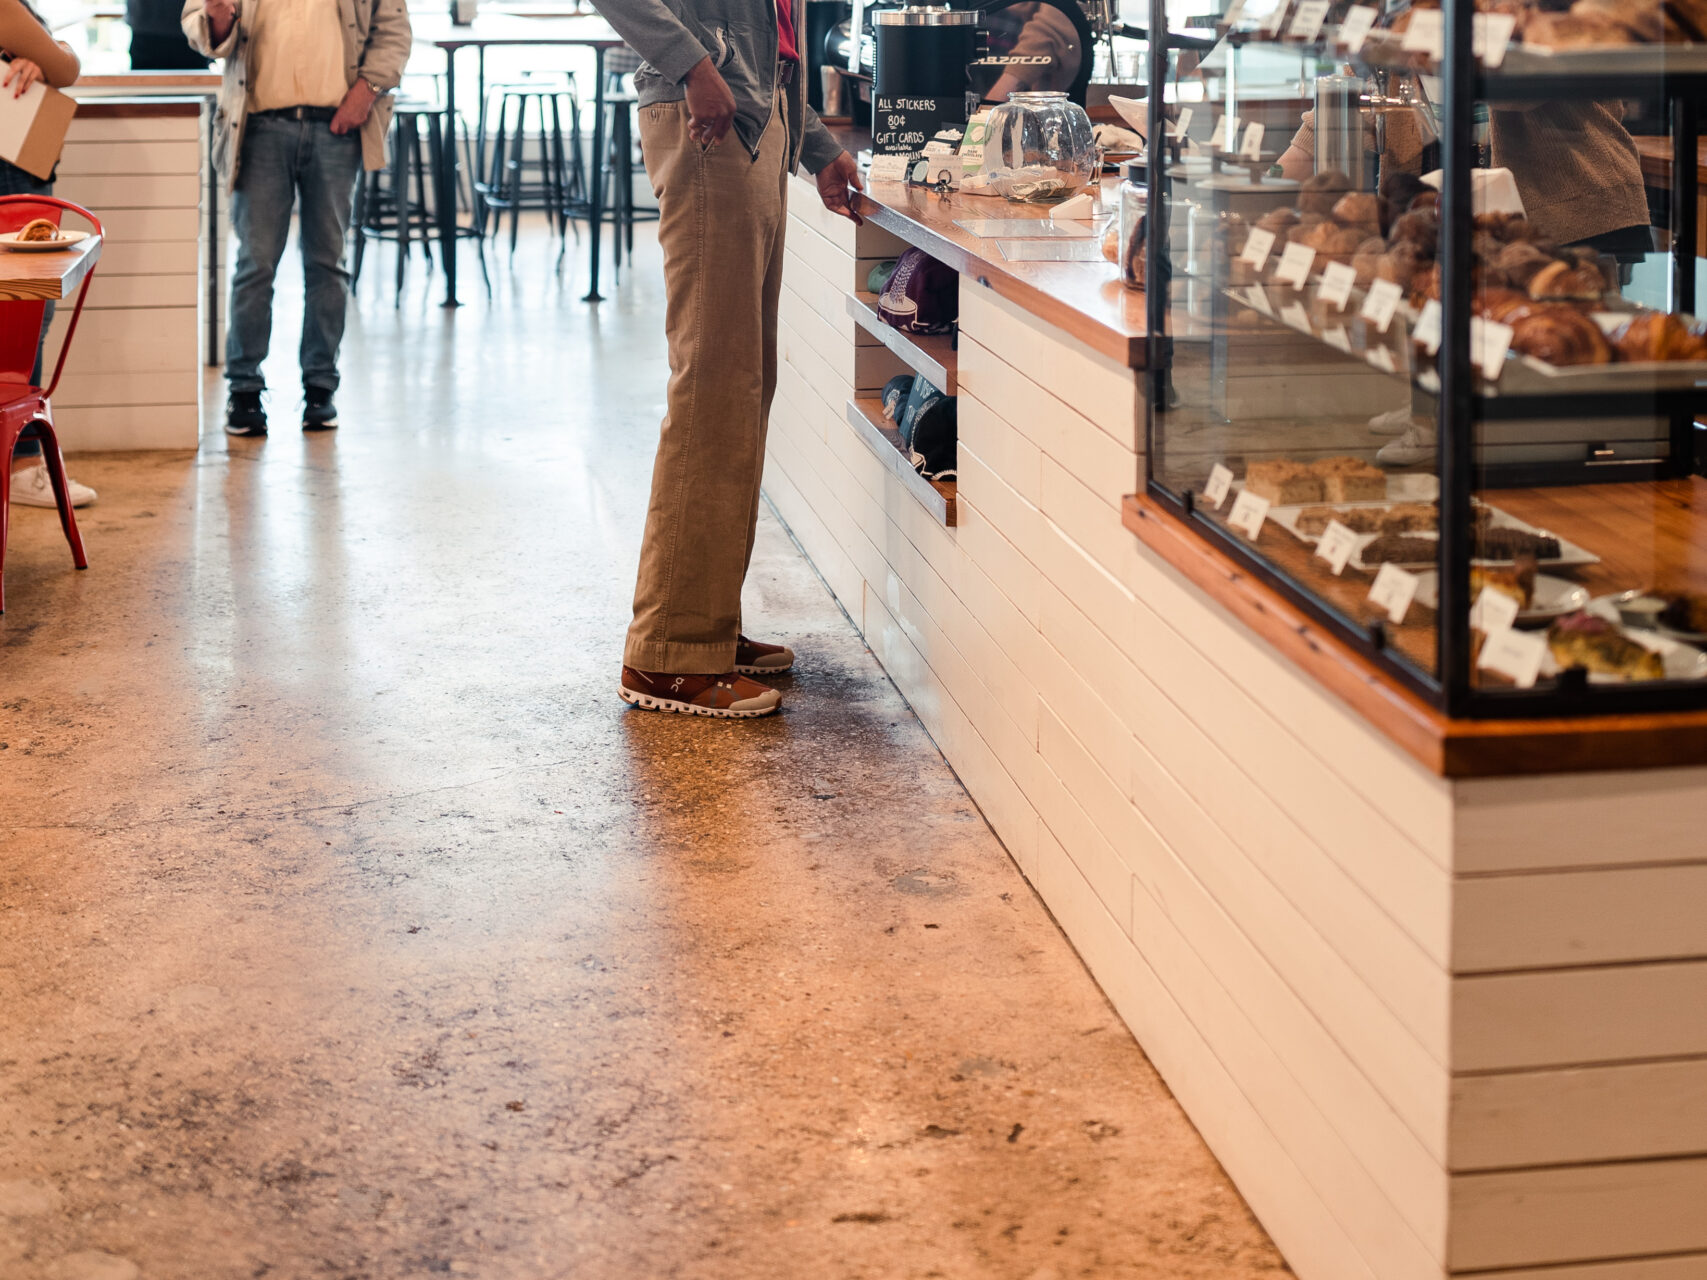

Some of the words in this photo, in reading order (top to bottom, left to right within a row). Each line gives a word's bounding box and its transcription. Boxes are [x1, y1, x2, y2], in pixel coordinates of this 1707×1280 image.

[878, 99, 892, 111] ALL
[896, 99, 936, 111] STICKERS
[887, 115, 905, 127] 80¢
[876, 132, 896, 144] GIFT
[899, 132, 925, 144] CARDS
